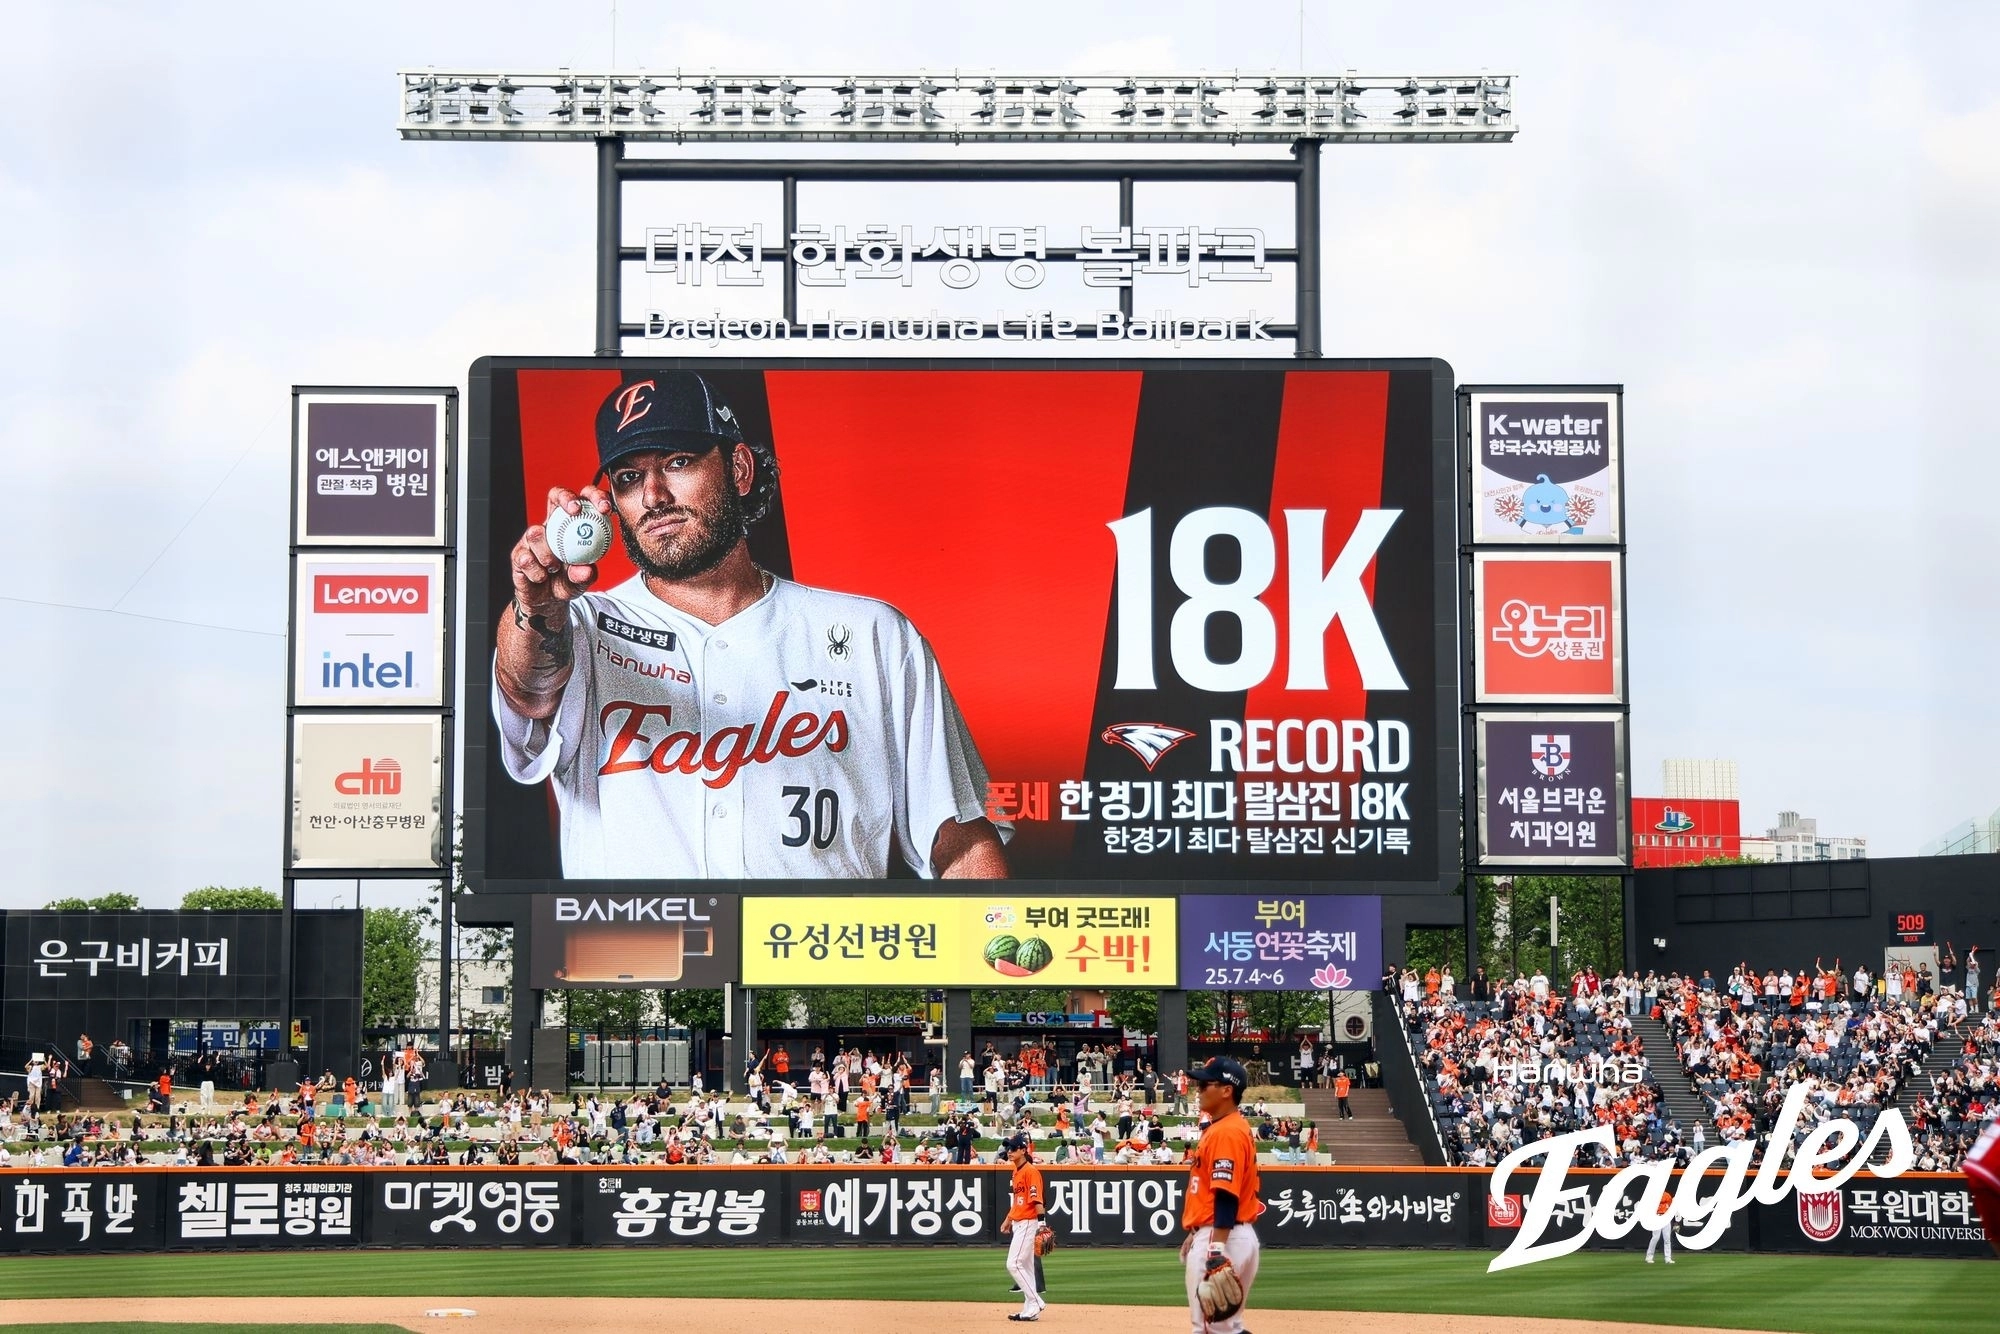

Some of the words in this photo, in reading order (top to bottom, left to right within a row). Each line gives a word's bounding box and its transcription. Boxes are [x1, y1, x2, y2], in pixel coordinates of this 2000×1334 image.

[645, 222, 765, 287] 대전
[791, 225, 1046, 288] 한화생명
[1076, 225, 1272, 287] 볼파크
[644, 308, 790, 347] Daejeon
[807, 309, 984, 341] Hanwha
[997, 309, 1078, 341] Life
[1097, 309, 1274, 347] Ballpark
[1488, 414, 1602, 436] K-water
[315, 448, 428, 473] 에스앤케이
[1489, 439, 1602, 456] 한국수자원공사
[386, 473, 428, 497] 병원
[324, 583, 419, 605] Lenovo
[1105, 507, 1409, 692] 18K
[604, 617, 669, 647] 한화생명
[1493, 600, 1604, 656] 온누리
[597, 640, 692, 685] Hanwha
[1554, 641, 1601, 657] 상품권
[322, 651, 413, 688] intel
[820, 679, 852, 689] LIFE
[821, 686, 852, 697] PLUS
[597, 690, 849, 789] Eagles
[1210, 719, 1410, 773] RECORD
[1531, 768, 1572, 782] BROWN
[986, 782, 1049, 821] 폰세
[1059, 780, 1094, 821] 한
[1100, 780, 1162, 821] 경기
[1171, 780, 1238, 821] 최다
[1244, 780, 1341, 821] 탈삼진
[1350, 782, 1410, 821] 18K
[1498, 786, 1606, 814] 서울브라운
[309, 815, 426, 830] 천안·아산충무병원
[781, 785, 839, 850] 30
[1103, 827, 1180, 854] 한경기
[1187, 827, 1240, 854] 최다
[1246, 827, 1324, 854] 탈삼진
[1331, 827, 1411, 854] 신기록
[1510, 821, 1596, 847] 치과의원
[556, 898, 710, 921] BAMKEL
[1025, 907, 1069, 929] 부여
[1076, 907, 1150, 929] 굿뜨래!
[1255, 901, 1305, 928] 부여
[1897, 914, 1924, 930] 509
[763, 923, 937, 961] 유성선병원
[1066, 935, 1150, 973] 수박!
[1204, 932, 1357, 961] 서동연꽃축제
[34, 938, 228, 976] 은구비커피
[1205, 968, 1285, 986] 25.7.4~6
[867, 1015, 920, 1024] BAMKEL
[1026, 1012, 1064, 1025] GS25
[285, 1183, 301, 1194] 청주
[303, 1183, 353, 1194] 재활의료기관
[178, 1182, 280, 1238] 첼로
[284, 1197, 352, 1235] 병원
[384, 1181, 560, 1233] 마켓영동
[612, 1187, 765, 1238] 홈런볼
[824, 1178, 983, 1235] 예가정성
[1047, 1179, 1182, 1236] 제비앙
[1850, 1225, 1918, 1239] MOKWON
[1921, 1226, 1990, 1241] UNIVERSI
